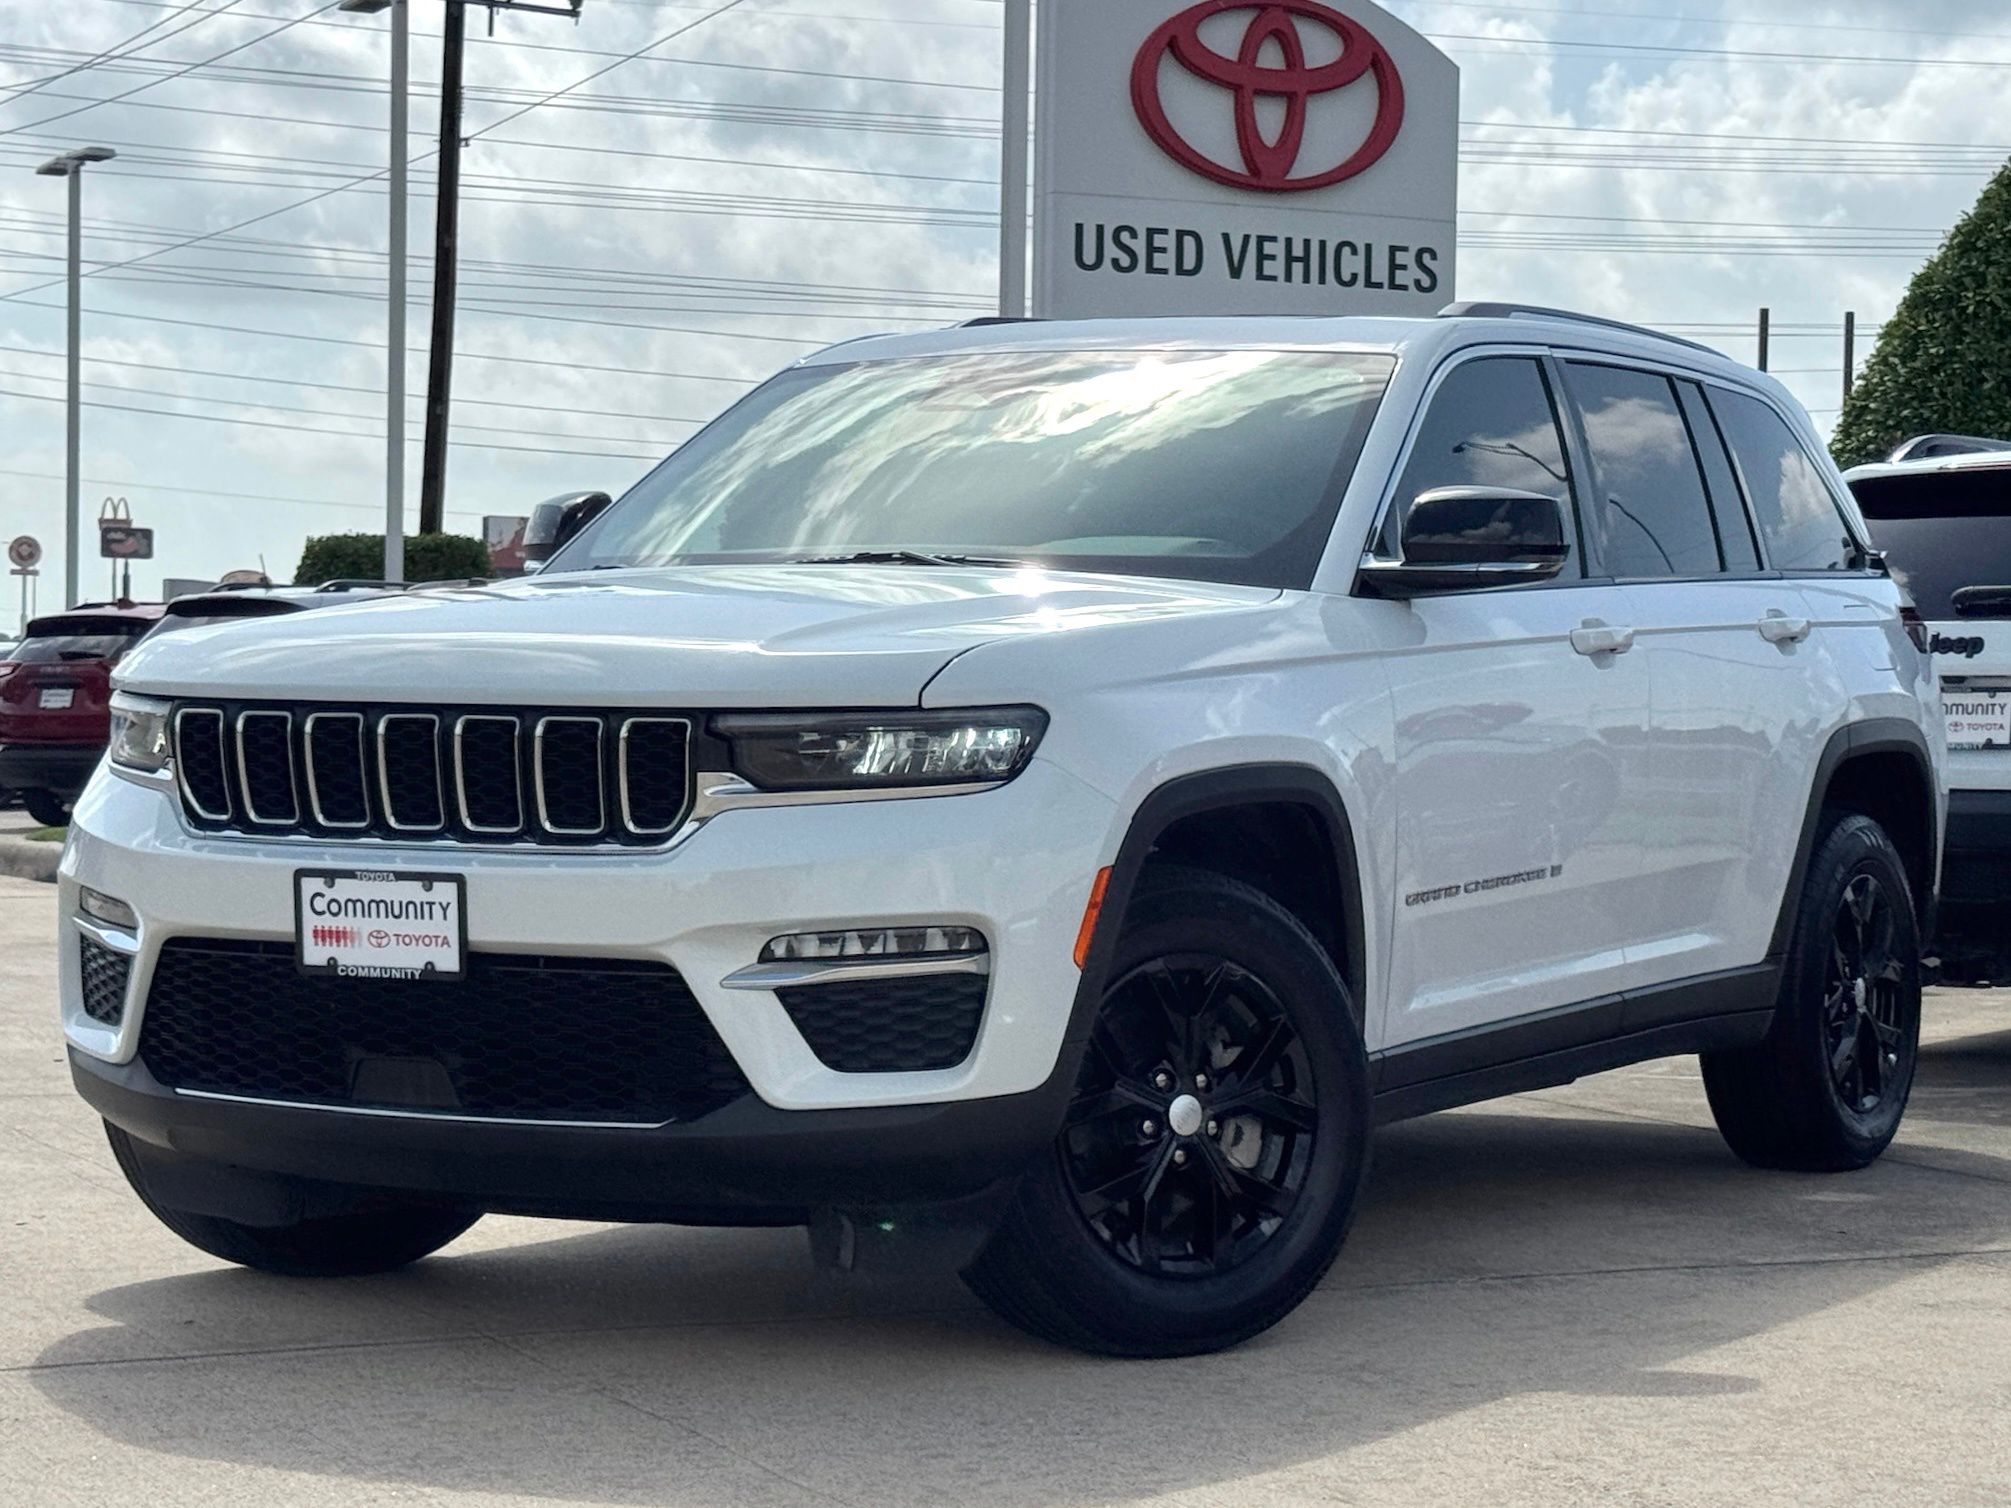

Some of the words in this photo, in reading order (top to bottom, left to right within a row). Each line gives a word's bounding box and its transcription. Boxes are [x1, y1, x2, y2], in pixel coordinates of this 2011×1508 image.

[1074, 222, 1204, 277] USED
[1220, 232, 1439, 294] VEHICLES
[1966, 723, 2005, 732] TOYOTA
[355, 871, 396, 882] TOYOTA
[393, 934, 452, 948] TOYOTA
[337, 966, 422, 980] COMMUNITY
